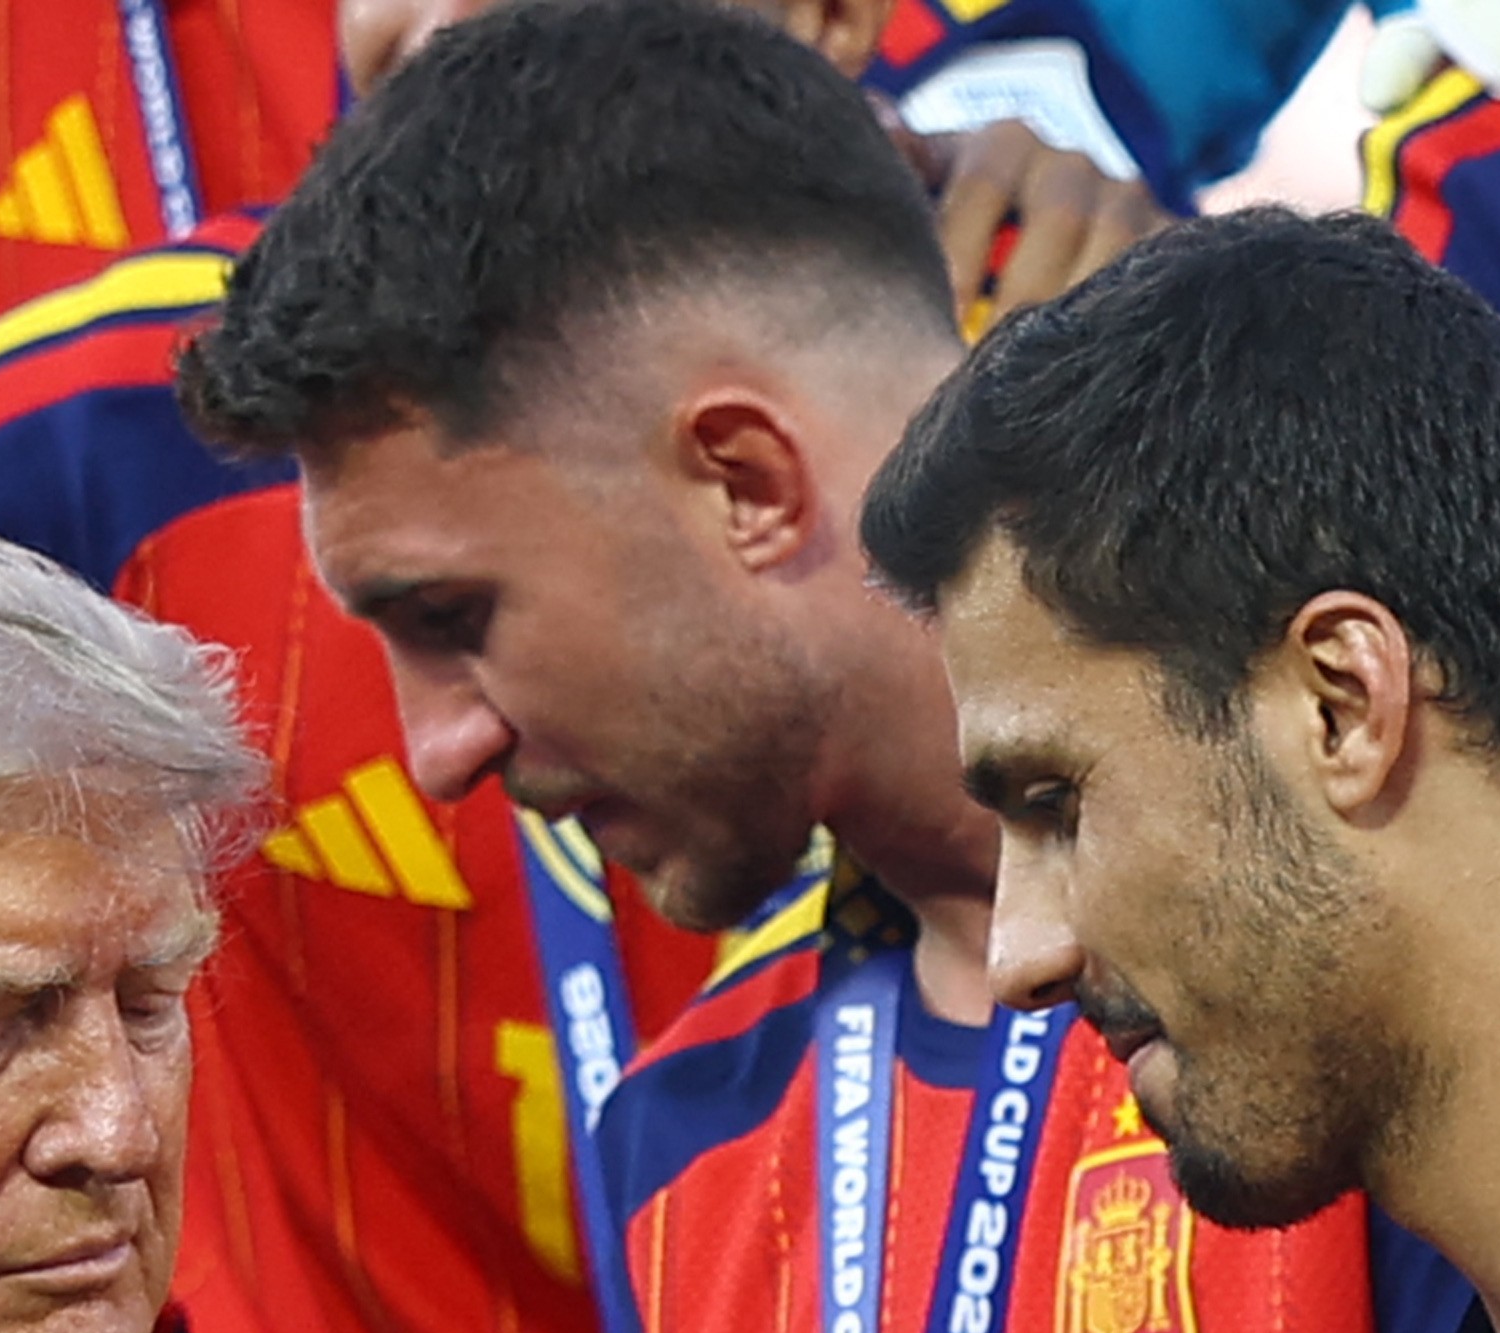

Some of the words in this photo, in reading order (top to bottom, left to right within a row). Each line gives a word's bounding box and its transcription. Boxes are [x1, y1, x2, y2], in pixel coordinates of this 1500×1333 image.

[559, 961, 622, 1136] 026
[832, 1003, 875, 1119] FIFA
[831, 1117, 870, 1308] WORLD
[979, 1088, 1030, 1198] CUP
